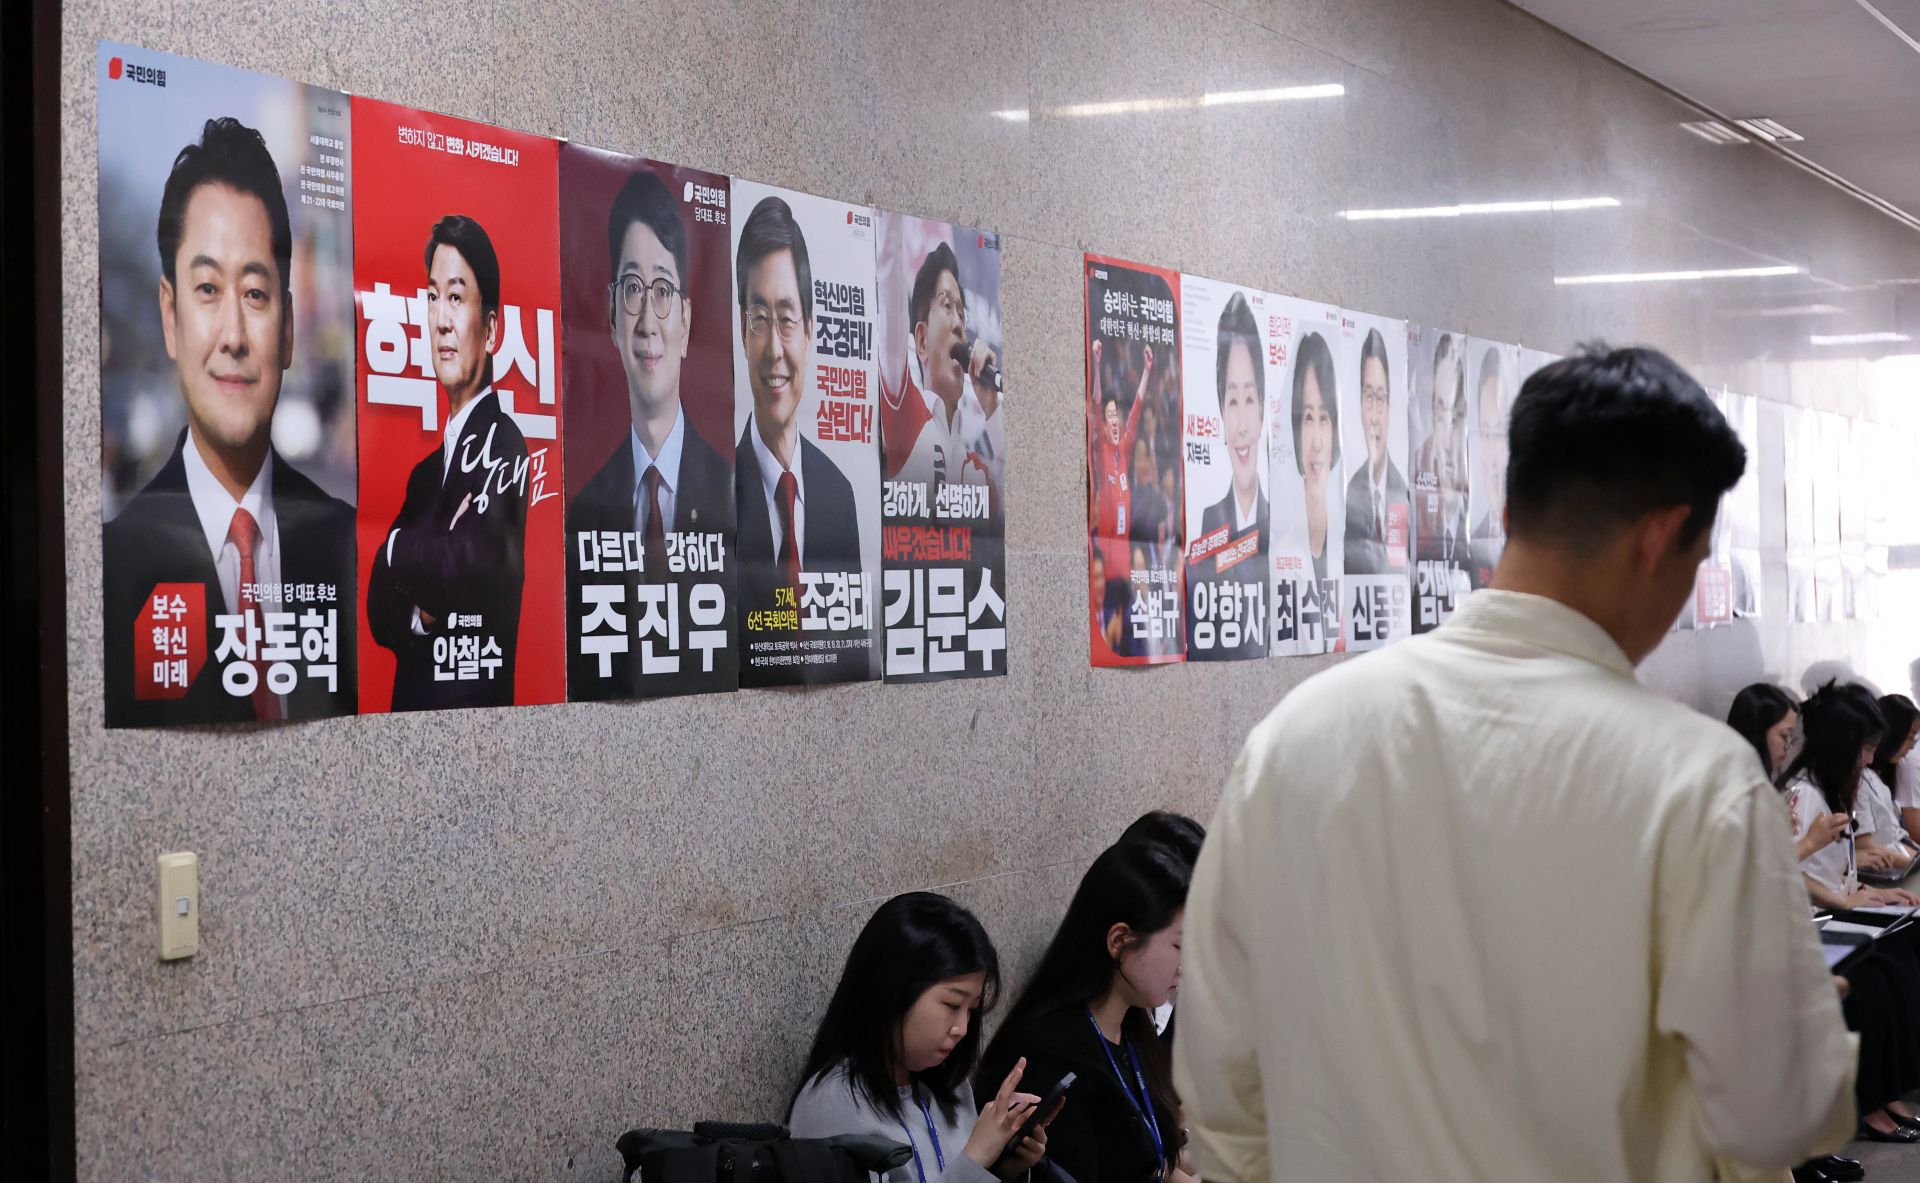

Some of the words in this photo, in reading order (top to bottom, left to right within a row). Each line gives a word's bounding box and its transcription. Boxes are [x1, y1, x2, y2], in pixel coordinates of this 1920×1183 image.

[126, 63, 167, 88] 국민의힘
[398, 125, 425, 148] 변하지
[427, 131, 445, 151] 않고
[446, 135, 464, 156] 변화
[466, 140, 519, 167] 시키겠습니다!
[694, 184, 726, 208] 국민의힘
[714, 210, 727, 225] 후보
[814, 279, 865, 317] 혁신의힘
[1103, 288, 1138, 318] 승리하는
[1140, 295, 1174, 324] 국민의힘
[816, 315, 873, 361] 조경태!
[1100, 316, 1125, 338] 대한민국
[1161, 328, 1174, 346] 리더
[361, 281, 557, 440] 혁신
[817, 364, 867, 400] 국민의힘
[817, 399, 873, 443] 살린다!
[460, 422, 559, 515] 당대표
[1186, 442, 1211, 465] 자부심
[883, 481, 931, 519] 강하게,
[935, 482, 990, 519] 선명하게
[578, 530, 645, 573] 다르다
[665, 531, 726, 573] 강하다
[883, 525, 971, 561] 싸우겠습니다!
[151, 594, 188, 622] 보수
[241, 582, 281, 602] 국민의힘
[317, 583, 337, 603] 후보
[775, 586, 797, 609] 57세,
[798, 571, 873, 631] 조경태
[1278, 579, 1340, 641] 최수진
[1417, 559, 1459, 625] 김민
[458, 614, 482, 628] 국민의힘
[580, 582, 728, 678] 주진우
[747, 610, 763, 631] 6선
[764, 609, 799, 631] 국회의원
[884, 566, 1006, 676] 김문수
[1130, 589, 1180, 639] 손범규
[1193, 580, 1266, 649] 양향자
[151, 626, 188, 655] 혁신
[214, 608, 338, 697] 장동혁
[433, 635, 503, 681] 안철수
[152, 659, 188, 689] 미래
